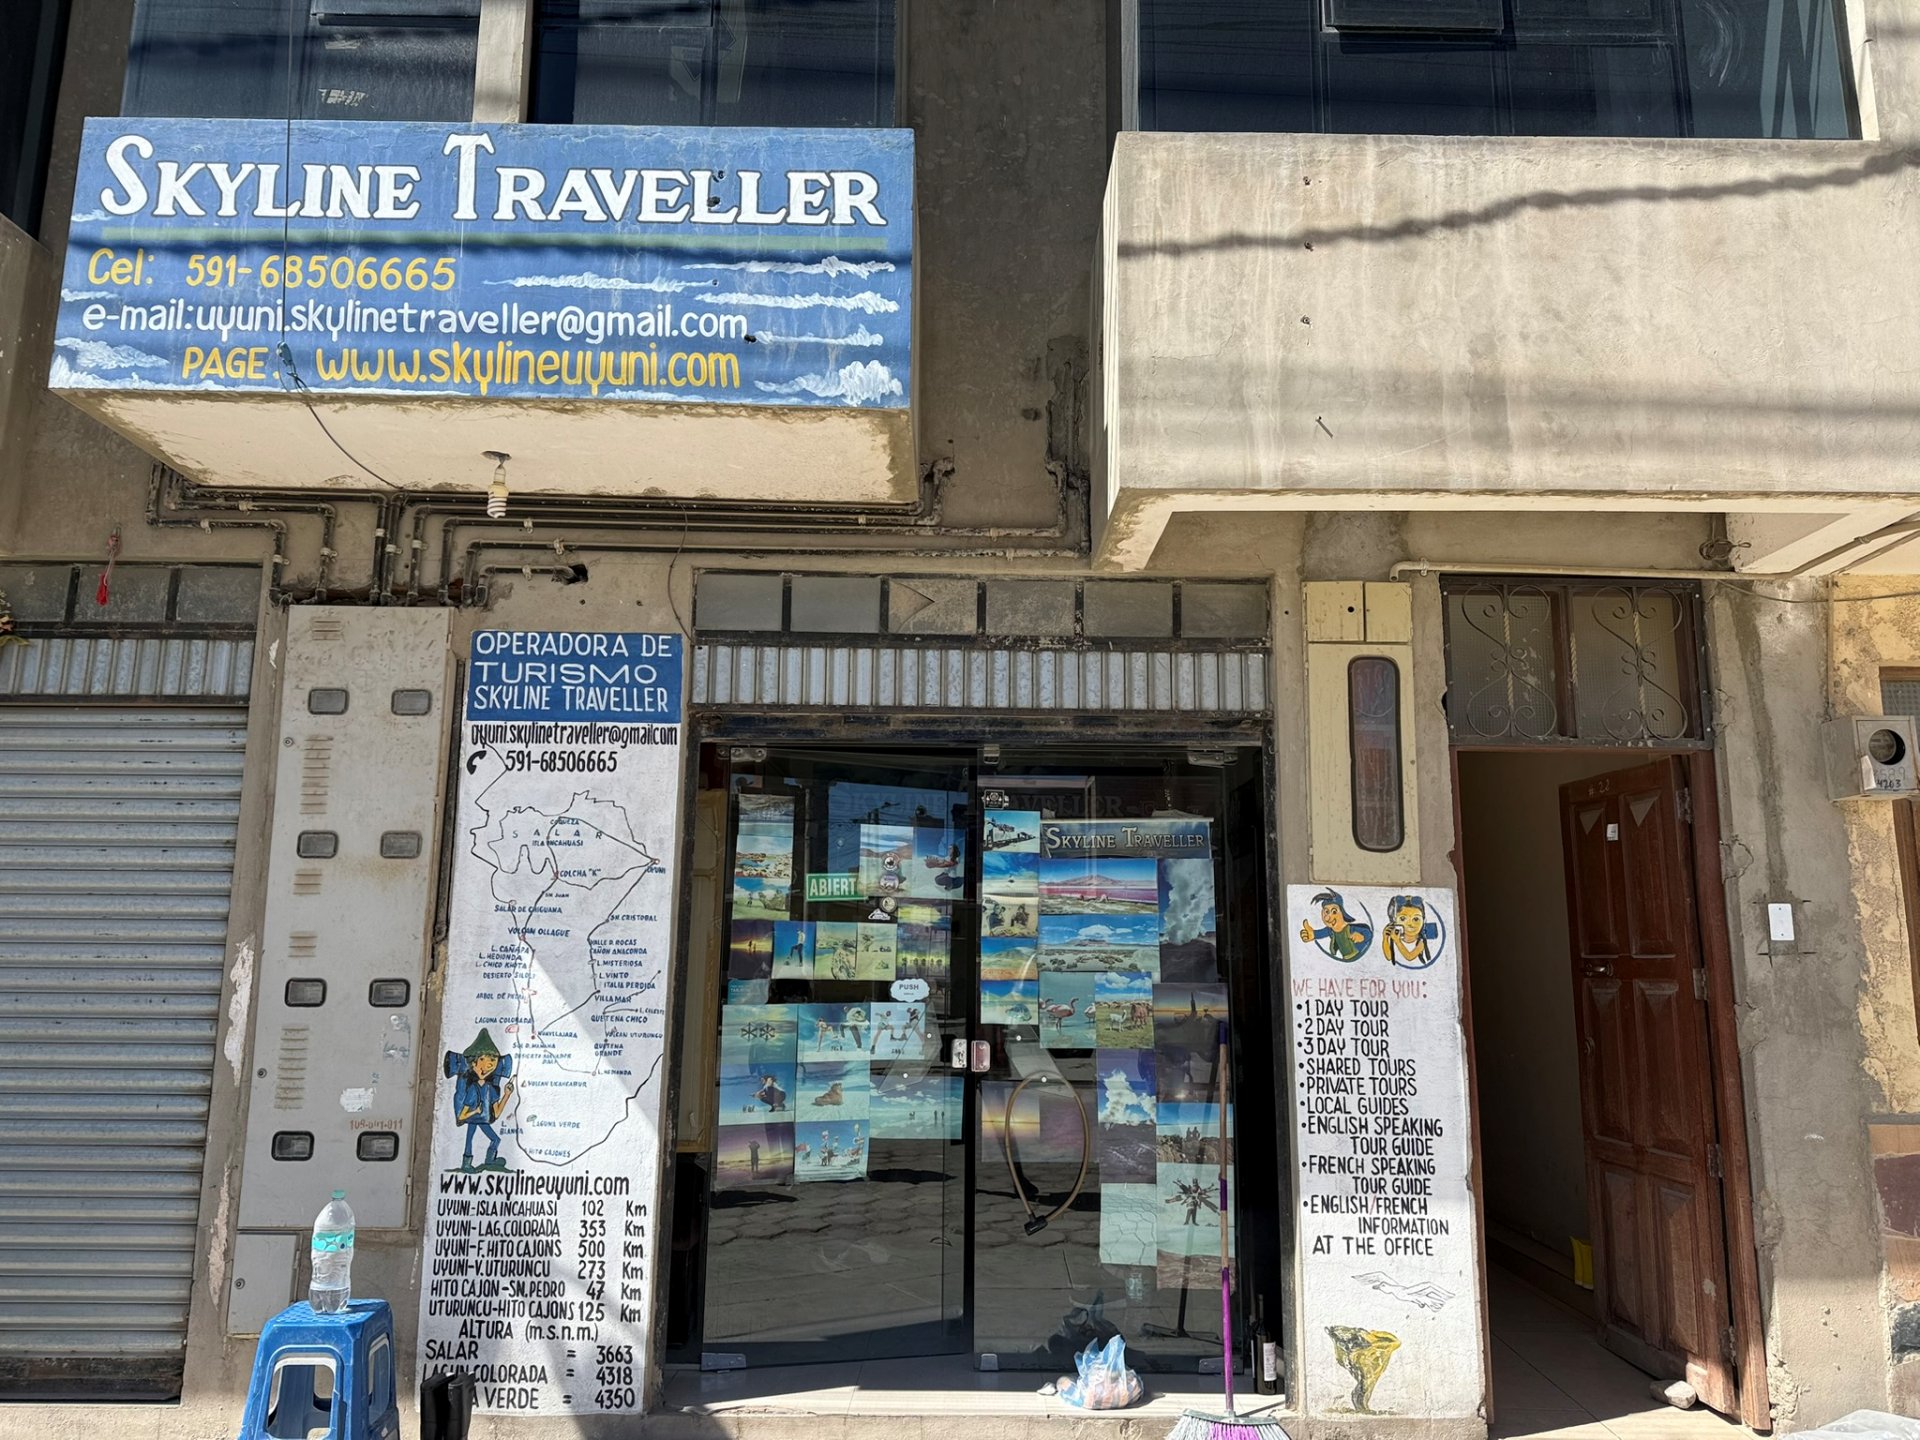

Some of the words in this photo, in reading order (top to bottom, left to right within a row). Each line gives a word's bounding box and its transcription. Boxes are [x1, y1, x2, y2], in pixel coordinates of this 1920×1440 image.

[100, 134, 421, 220] SKYLINE
[443, 132, 888, 226] TRAVELLER
[88, 249, 154, 286] Cel:
[186, 254, 457, 291] 591-68506665
[316, 340, 740, 397] www.skylineuyuni.com
[476, 632, 629, 657] OPERADORA
[641, 634, 673, 657] DE
[474, 662, 657, 684] TURISMO
[474, 685, 552, 710] SKYLINE
[562, 686, 668, 712] TRAVELLER
[506, 750, 618, 772] 591-68506665
[1046, 827, 1116, 849] SKYLINE
[1122, 826, 1204, 848] TRAVELLER
[809, 878, 857, 897] ABIERT
[538, 928, 570, 937] OLLAGUE
[1292, 978, 1313, 997] WE
[1318, 978, 1354, 997] HAVE
[1360, 978, 1386, 998] FOR
[1392, 980, 1427, 999] YOU:
[1315, 999, 1344, 1017] DAY
[1350, 1000, 1389, 1018] TOUR
[1316, 1018, 1344, 1036] DAY
[1350, 1019, 1389, 1037] TOUR
[1317, 1038, 1346, 1056] DAY
[1350, 1038, 1390, 1057] TOUR
[1306, 1058, 1361, 1076] SHARED
[1368, 1058, 1416, 1076] TOURS
[1307, 1077, 1366, 1095] PRIVATE
[1368, 1077, 1417, 1096] TOURS
[1307, 1096, 1351, 1114] LOCAL
[1358, 1097, 1409, 1115] GUIDES
[1308, 1116, 1369, 1135] ENGLISH
[1374, 1117, 1443, 1137] SPEAKING
[1350, 1136, 1387, 1155] TOUR
[1392, 1137, 1434, 1156] GUIDE
[1309, 1155, 1365, 1174] FRENCH
[1371, 1157, 1435, 1176] SPEAKING
[1352, 1176, 1387, 1195] TOUR
[1392, 1178, 1432, 1196] GUIDE
[582, 1200, 604, 1217] 102
[626, 1201, 647, 1217] Km
[579, 1220, 606, 1237] 353
[625, 1221, 645, 1237] Km
[1358, 1217, 1449, 1236] INFORMATION
[578, 1240, 605, 1258] 500
[623, 1241, 644, 1258] Km
[1312, 1235, 1334, 1254] AT
[1342, 1237, 1376, 1255] THE
[1384, 1237, 1434, 1256] OFFICE
[578, 1260, 606, 1279] 273
[622, 1261, 643, 1280] Km
[431, 1279, 458, 1297] HITO
[586, 1280, 605, 1299] 47
[621, 1283, 642, 1300] Km
[528, 1301, 574, 1320] CAJONS
[579, 1304, 605, 1322] 125
[620, 1304, 641, 1322] Km
[458, 1319, 514, 1339] ALTURA
[425, 1340, 478, 1360] SALAR
[596, 1345, 633, 1364] 3663
[473, 1364, 548, 1384] COLORADA
[596, 1367, 633, 1387] 4318
[485, 1388, 539, 1409] VERDE
[594, 1388, 635, 1409] 4350
